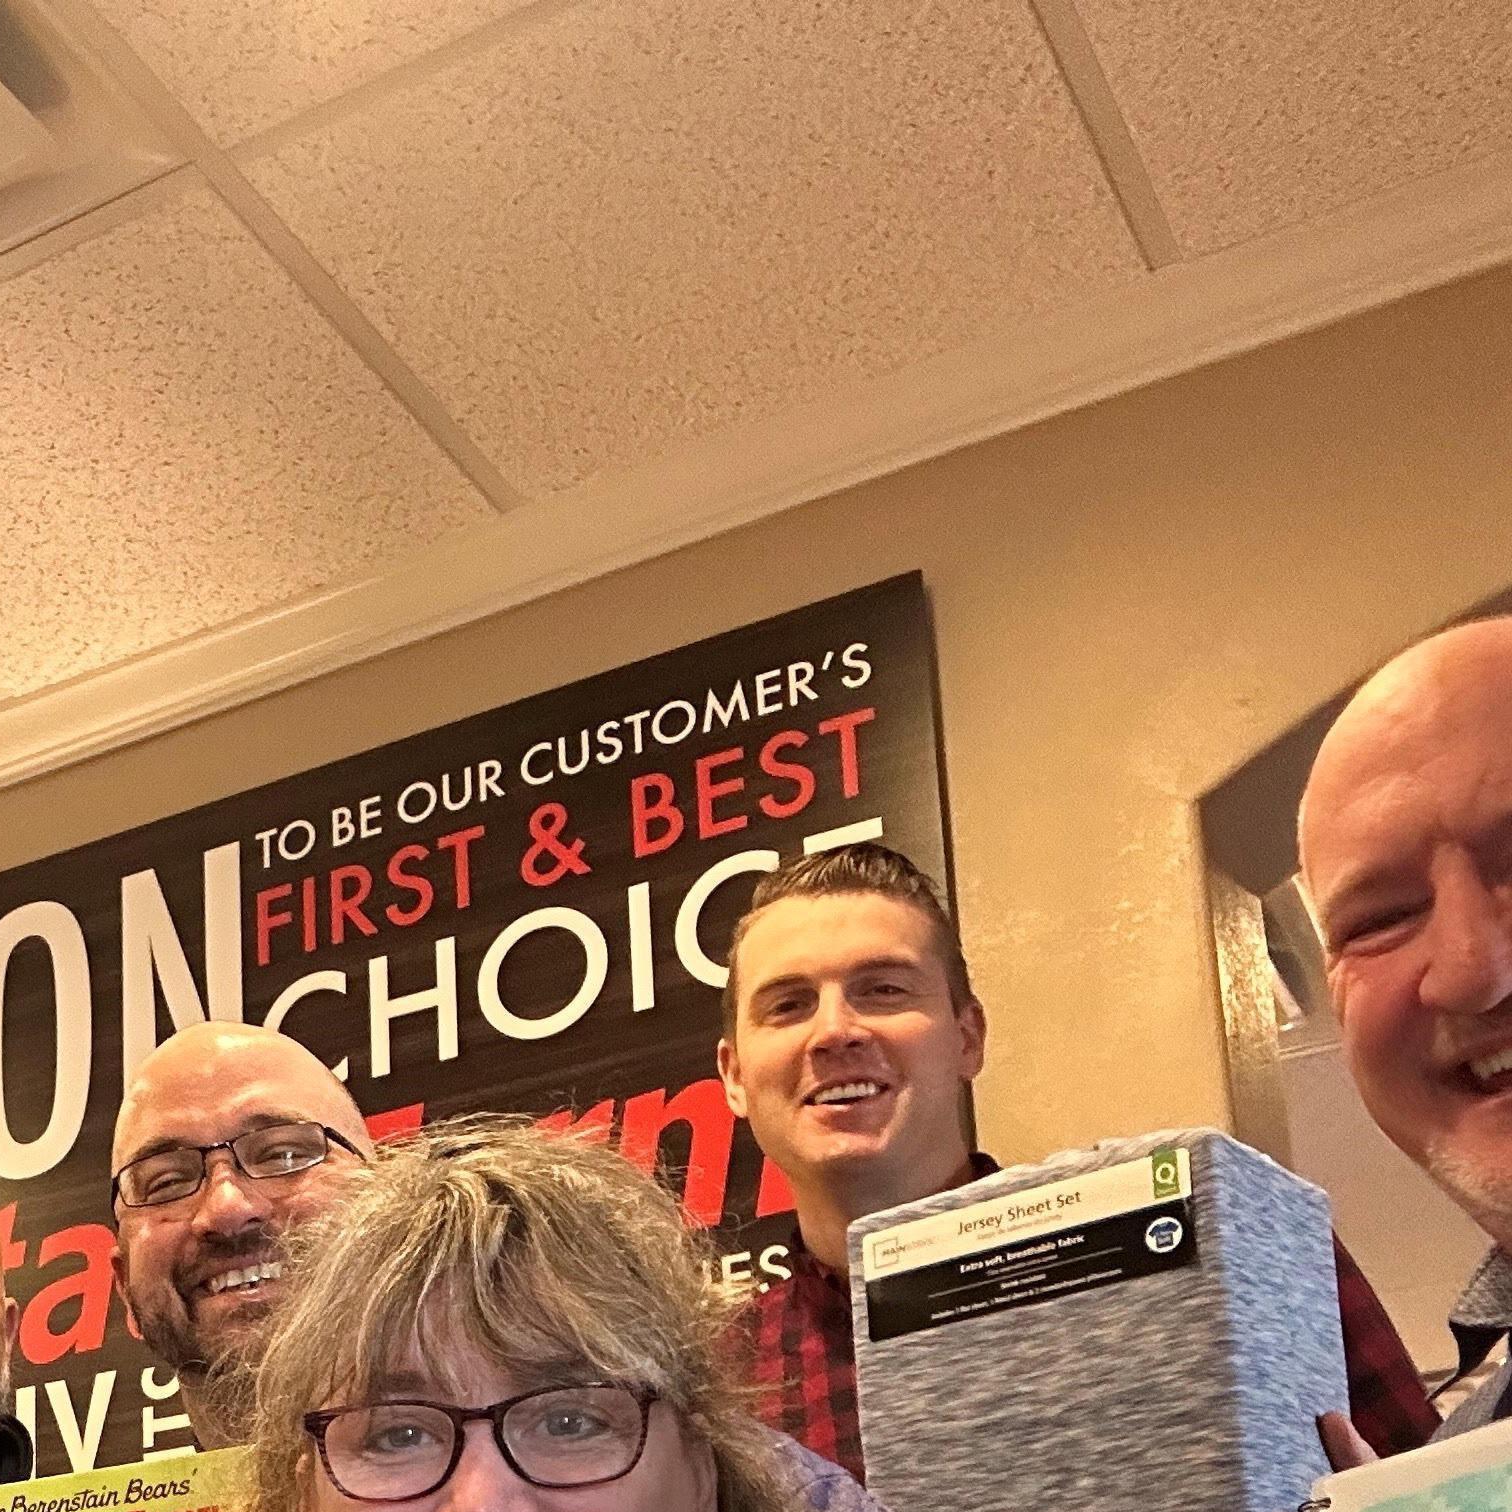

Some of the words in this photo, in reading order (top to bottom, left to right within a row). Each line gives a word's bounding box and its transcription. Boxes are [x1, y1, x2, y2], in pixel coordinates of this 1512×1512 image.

[254, 820, 316, 869] TO
[330, 795, 383, 847] BE
[396, 759, 506, 825] OUR
[519, 642, 873, 786] CUSTOMER'S
[254, 826, 486, 967] FIRST
[520, 802, 592, 887] &
[631, 707, 877, 858] BEST
[263, 817, 884, 1081] CHOIC
[957, 1210, 1003, 1235] Jersey
[1007, 1199, 1052, 1221] Sheet
[1056, 1191, 1082, 1208] Set
[124, 1467, 199, 1504] Bears'
